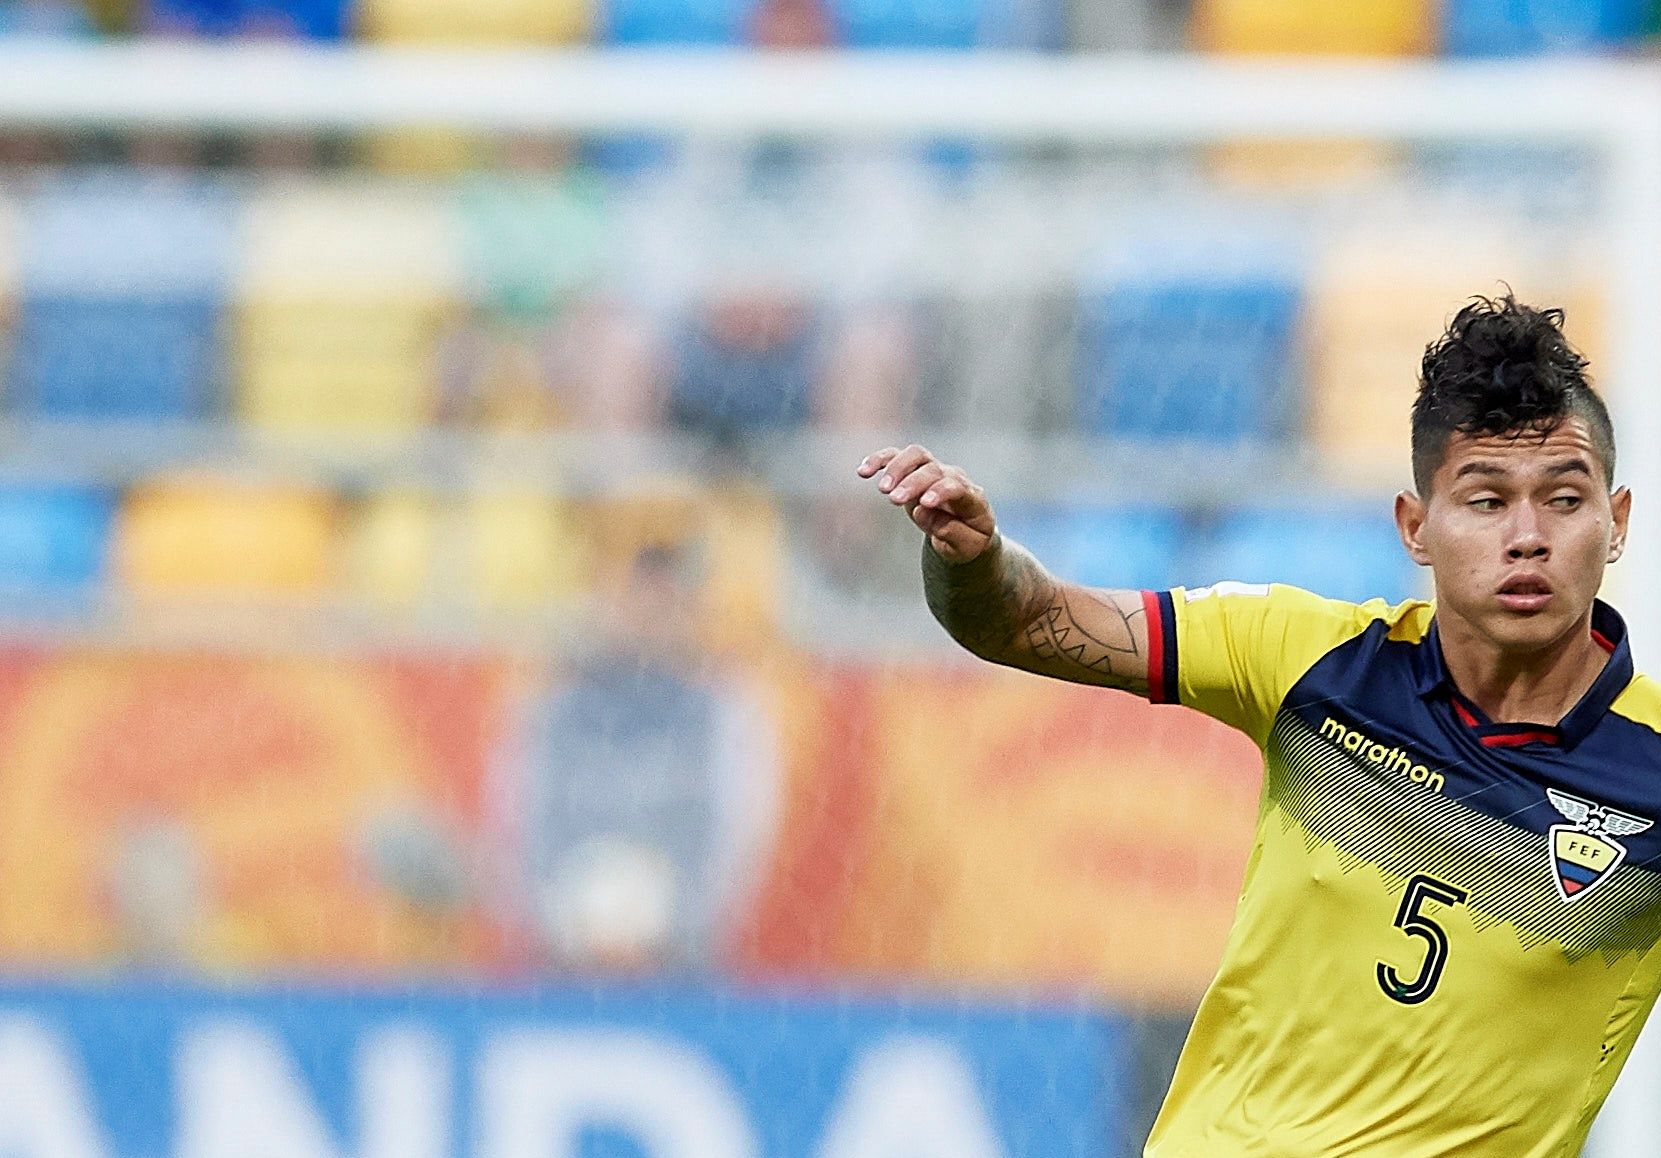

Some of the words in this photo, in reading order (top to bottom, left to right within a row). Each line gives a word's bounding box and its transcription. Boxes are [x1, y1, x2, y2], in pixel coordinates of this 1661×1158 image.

[1318, 714, 1446, 794] marathon
[1567, 839, 1602, 861] FEF
[1375, 871, 1471, 1006] 5
